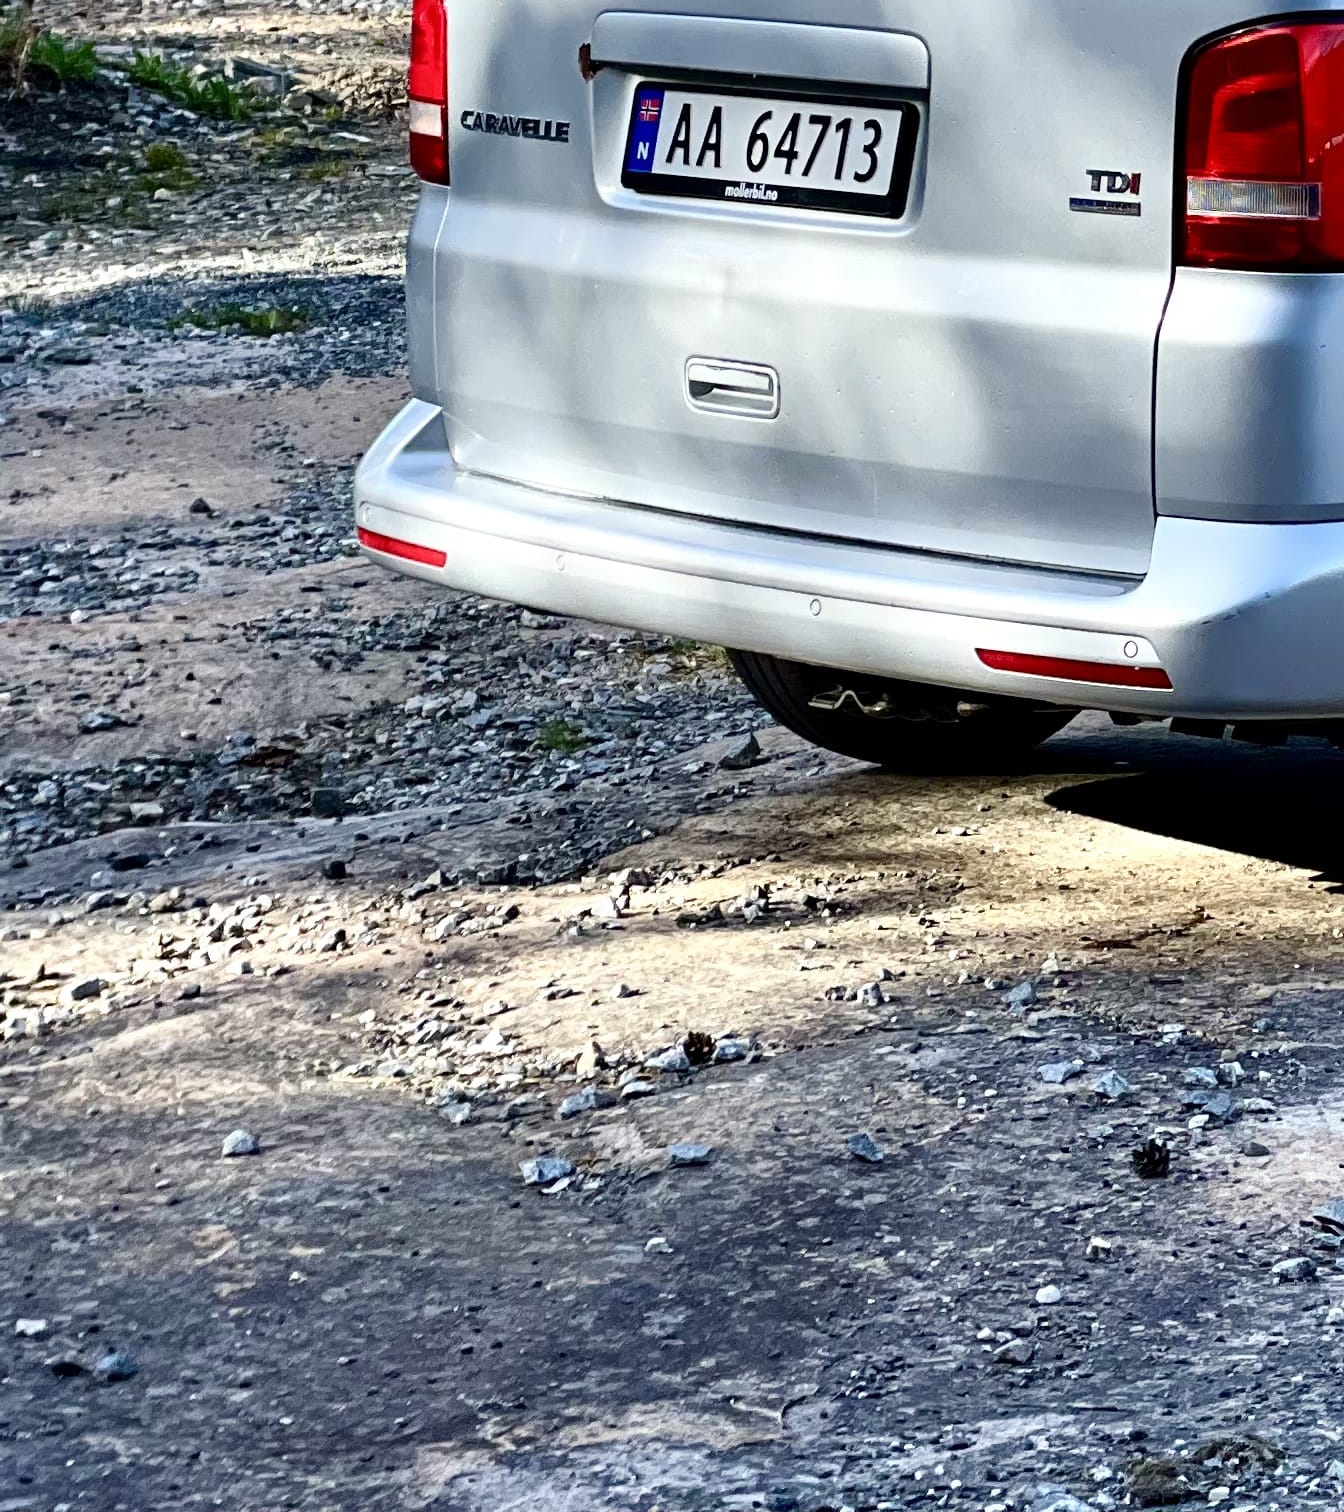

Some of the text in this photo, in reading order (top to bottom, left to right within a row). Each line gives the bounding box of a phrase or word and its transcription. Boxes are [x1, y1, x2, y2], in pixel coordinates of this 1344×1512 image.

[460, 110, 570, 143] CARAVELLE
[636, 141, 649, 160] N
[665, 103, 882, 183] AA 64713
[1086, 169, 1141, 195] TDI
